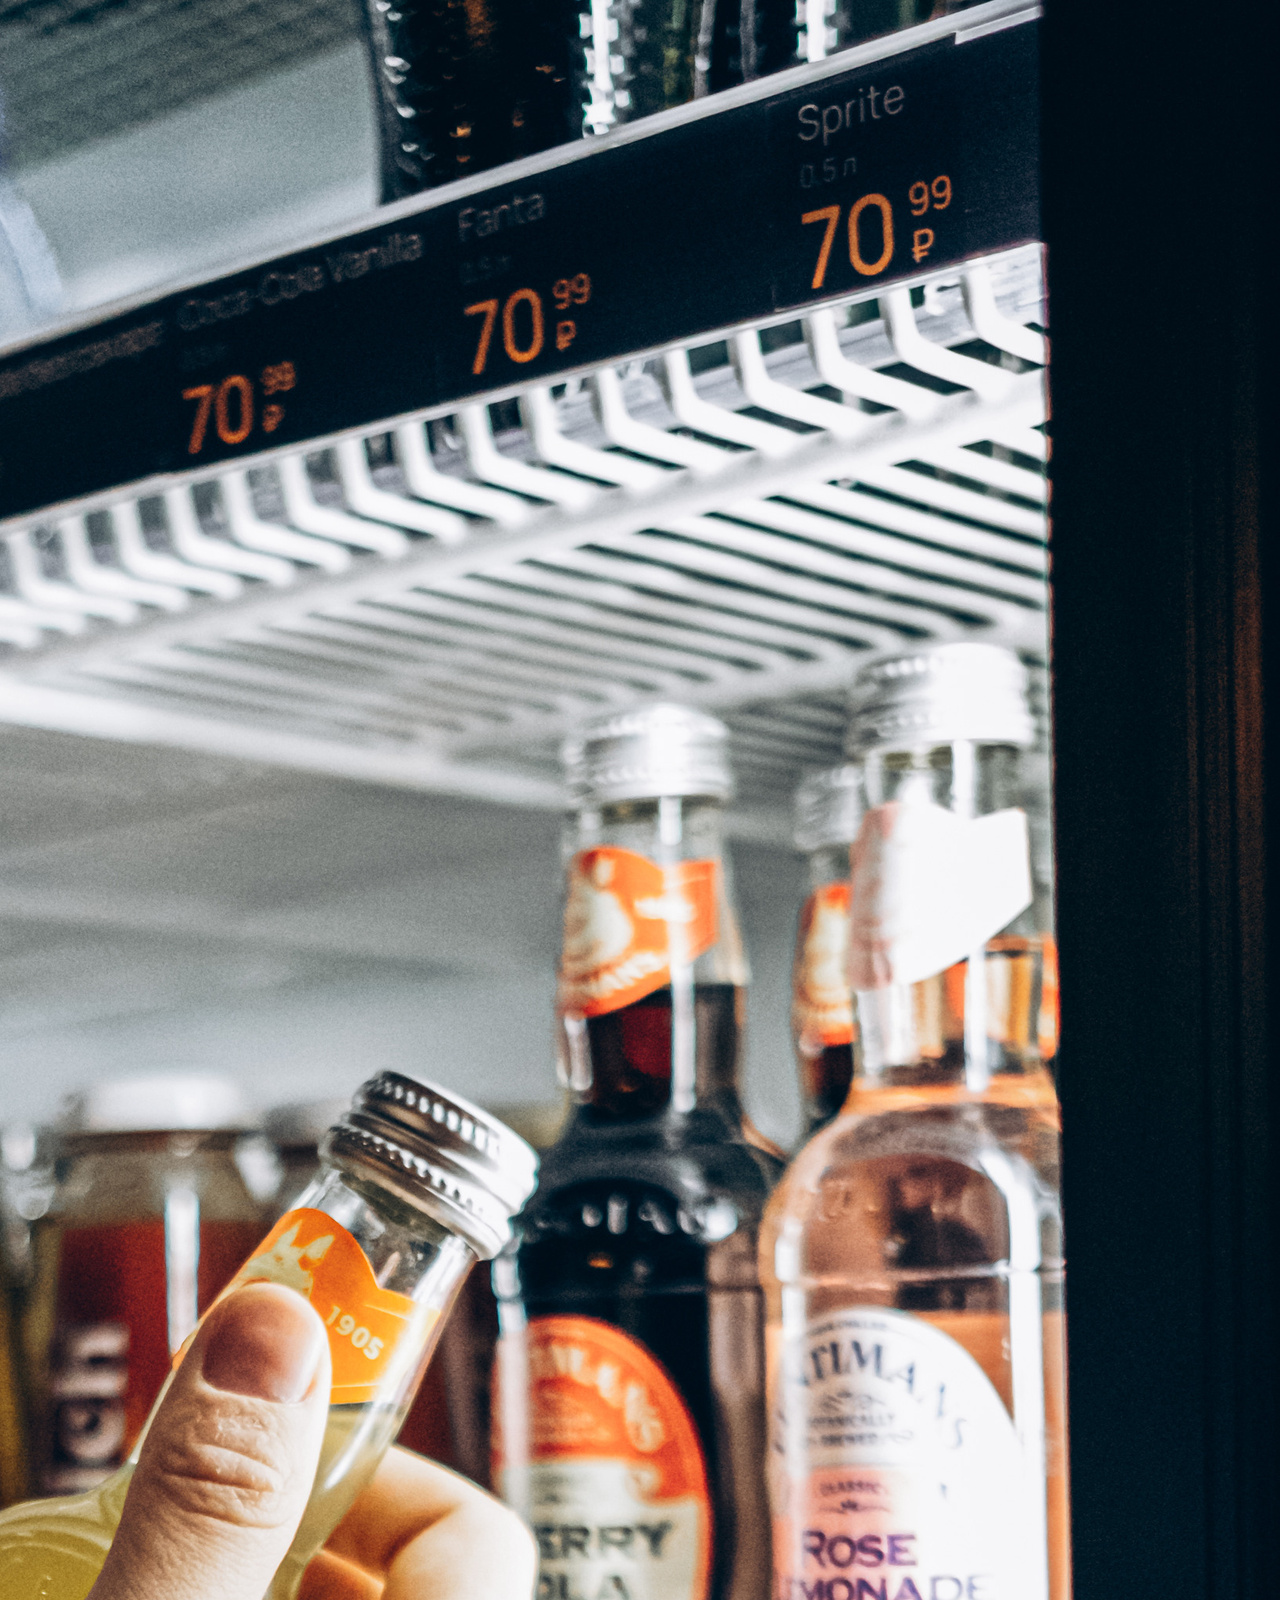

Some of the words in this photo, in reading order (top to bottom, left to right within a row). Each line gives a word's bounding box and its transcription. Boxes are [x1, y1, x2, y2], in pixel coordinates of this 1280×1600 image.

[797, 85, 905, 146] Sprite
[458, 193, 545, 242] Fanta
[801, 192, 895, 290] 70
[908, 174, 952, 217] 99
[464, 288, 544, 375] 70
[552, 272, 592, 310] 99
[182, 374, 254, 455] 70
[326, 1306, 385, 1360] 1905
[803, 1530, 917, 1568] ROSE
